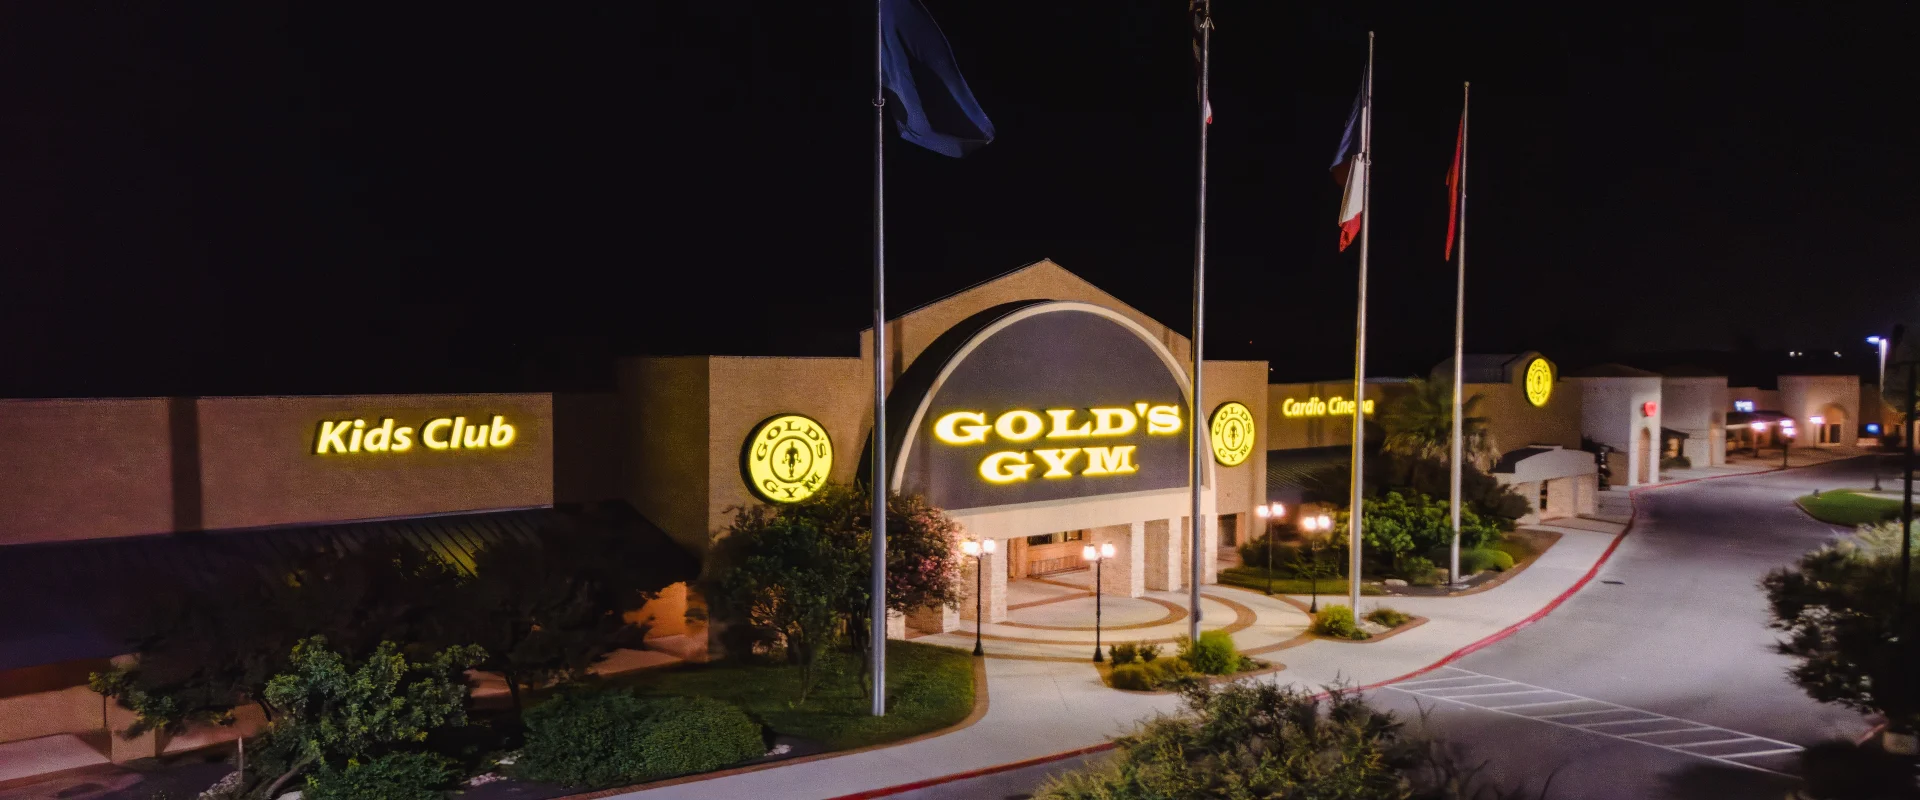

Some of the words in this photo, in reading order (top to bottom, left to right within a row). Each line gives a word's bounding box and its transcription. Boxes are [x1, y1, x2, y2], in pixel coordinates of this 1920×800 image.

[934, 402, 1183, 445] GOLD'S
[1215, 406, 1252, 436] GOLD'S
[1282, 396, 1326, 417] Cardio
[1327, 396, 1375, 415] Cinea
[315, 417, 413, 454] Kids
[421, 414, 515, 450] Club
[756, 420, 827, 462] GOLD'S
[979, 445, 1137, 484] GYM
[1218, 444, 1249, 462] GYM
[762, 472, 822, 499] GYM
